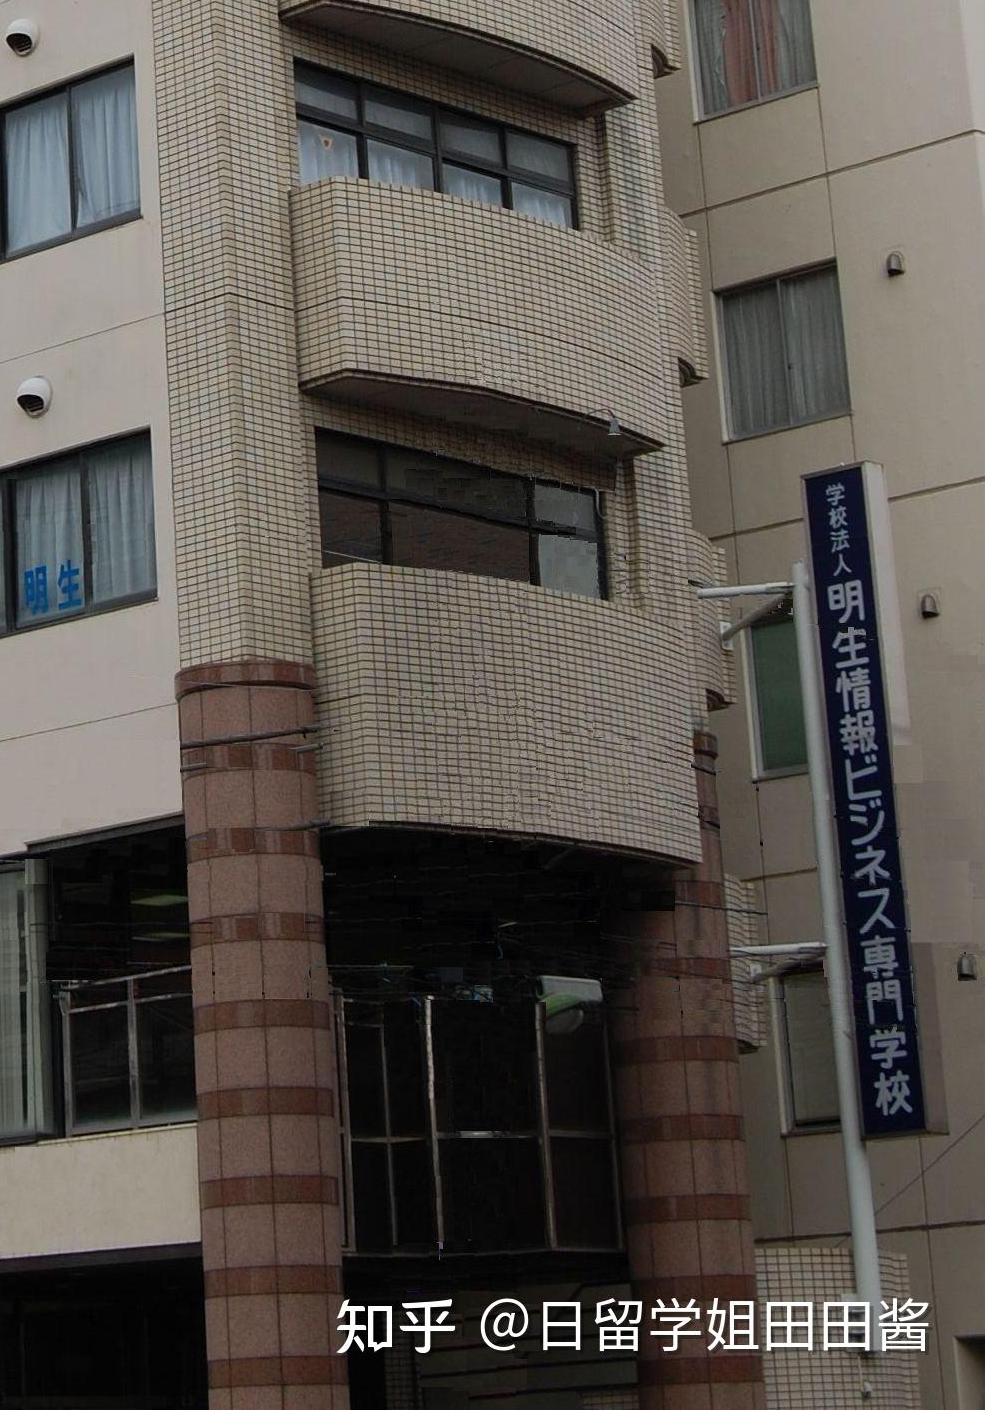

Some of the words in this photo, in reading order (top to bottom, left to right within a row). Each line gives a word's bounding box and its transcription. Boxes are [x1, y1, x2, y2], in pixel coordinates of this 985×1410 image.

[826, 483, 853, 576] 学校法人
[24, 560, 82, 615] 明生
[828, 580, 913, 1117] 明生情報ビジネス専門学校
